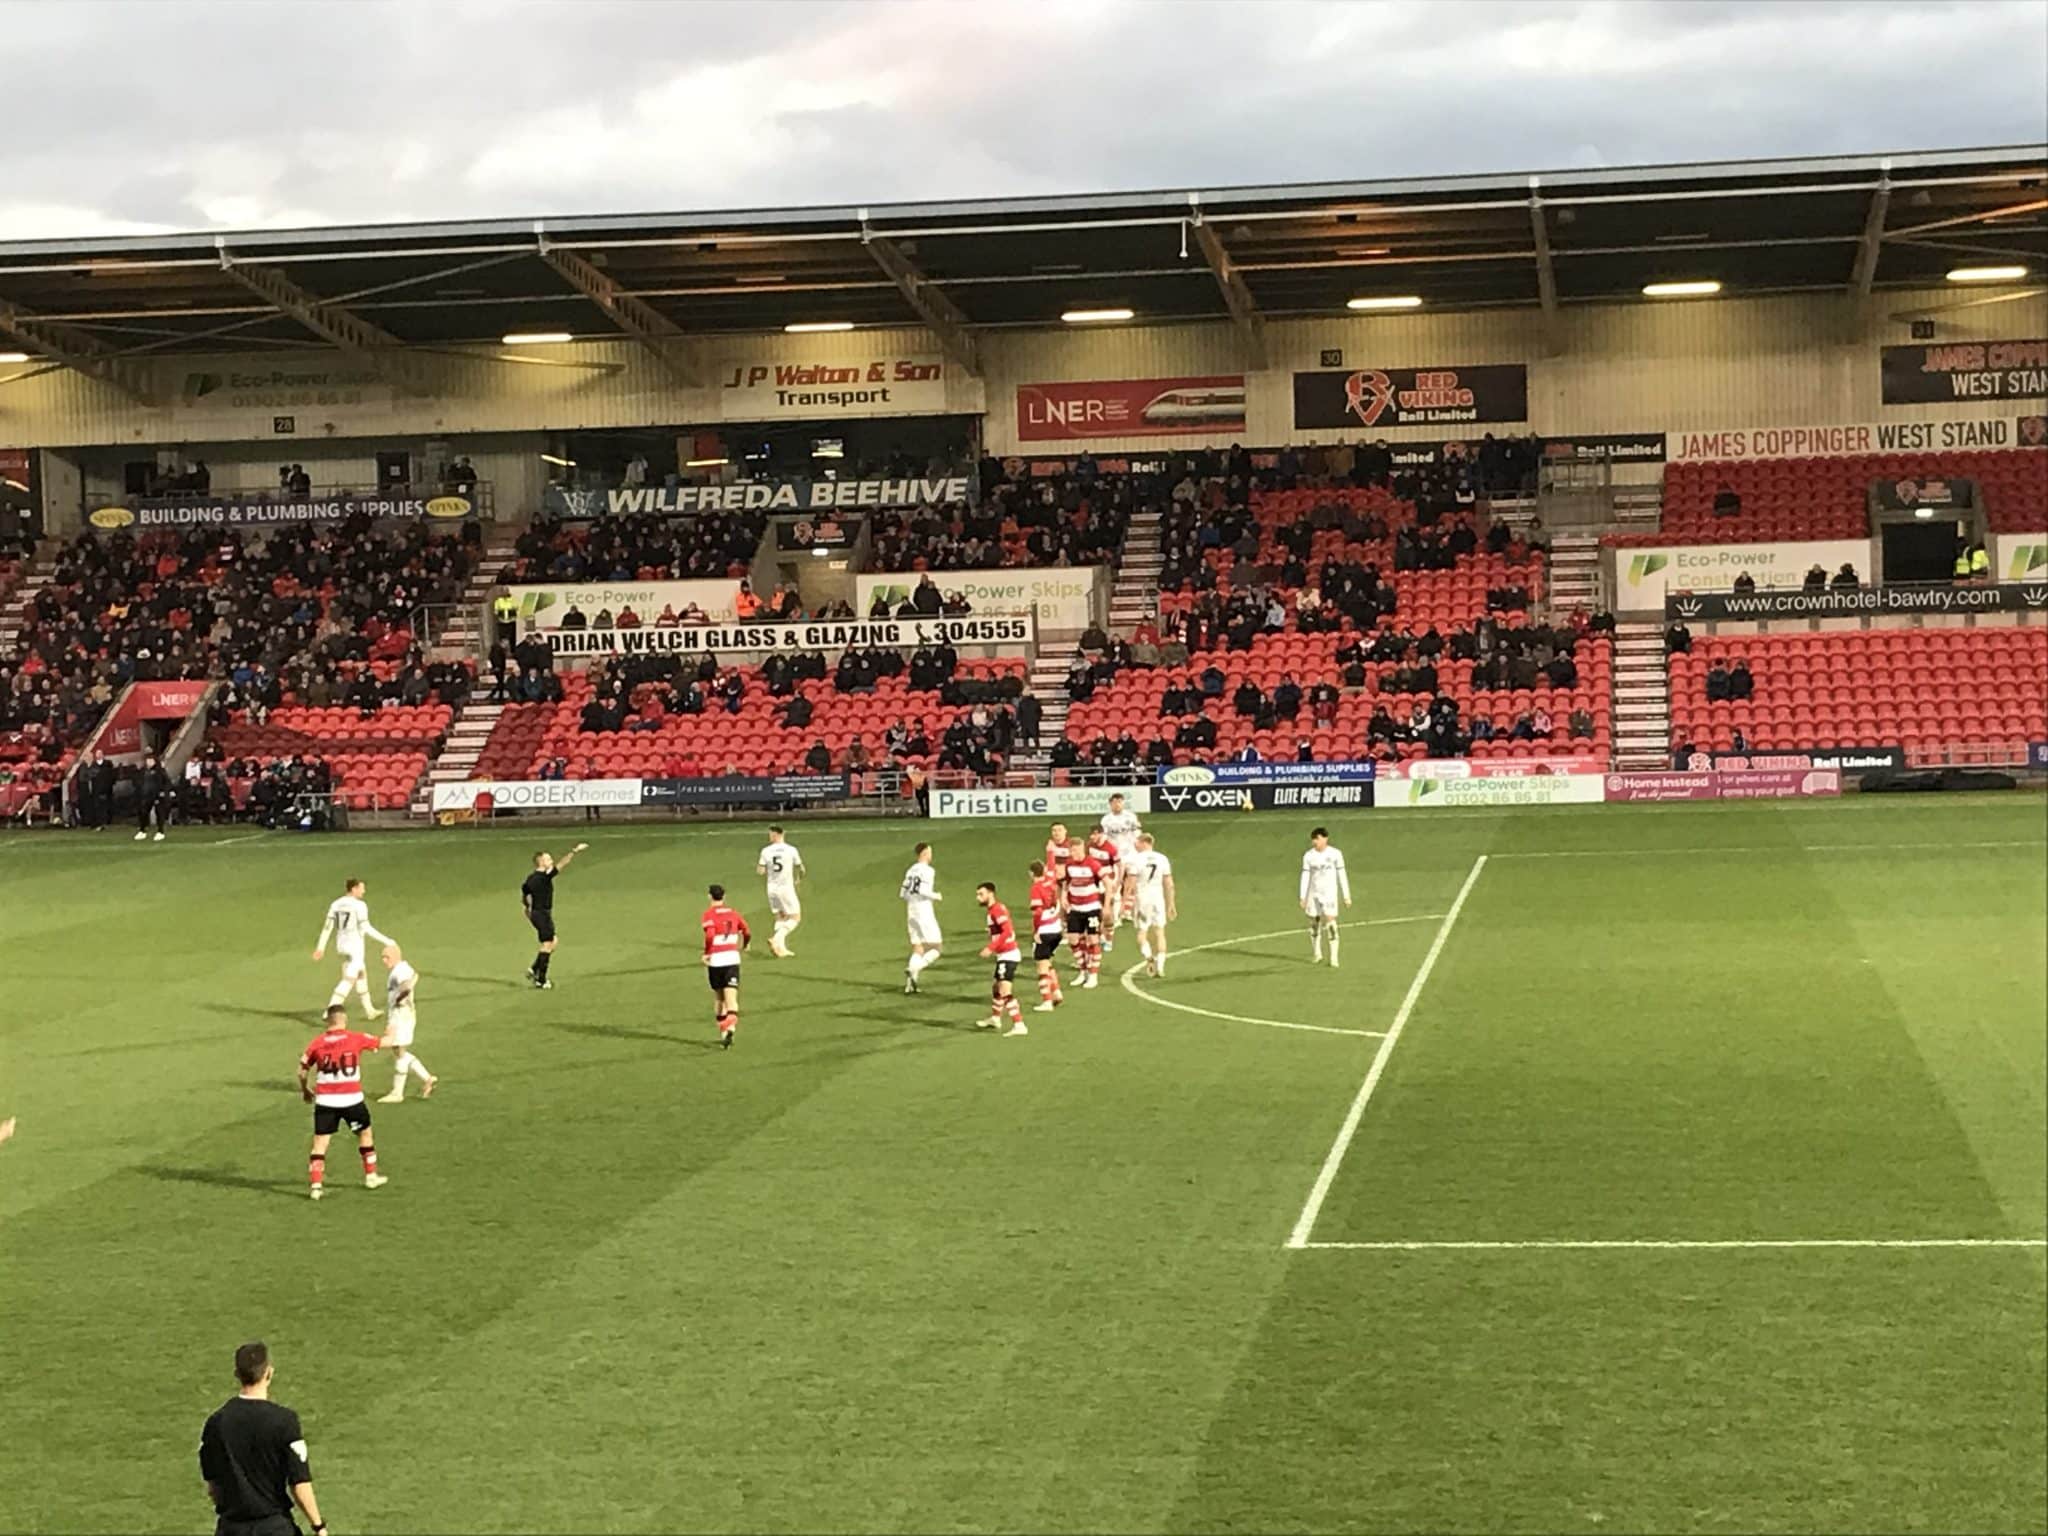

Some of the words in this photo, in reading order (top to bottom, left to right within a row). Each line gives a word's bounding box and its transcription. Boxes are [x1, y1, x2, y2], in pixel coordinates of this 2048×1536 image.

[1323, 351, 1340, 365] 30
[725, 368, 743, 388] J
[747, 366, 768, 387] P
[775, 365, 859, 386] Walton
[867, 362, 885, 382] &
[893, 361, 941, 381] Son
[1416, 372, 1458, 391] RED
[1951, 372, 2002, 396] WEST
[776, 388, 891, 407] Transport
[1400, 388, 1474, 408] VIKING
[1029, 398, 1105, 426] LNER
[1428, 408, 1477, 421] Limited
[276, 419, 293, 431] 28
[1677, 432, 1746, 458] JAMES
[1752, 426, 1870, 454] COPPINGER
[1877, 423, 1935, 449] WEST
[1941, 420, 2007, 447] STAND
[608, 484, 798, 512] WILFREDA
[810, 477, 968, 506] BEEHIVE
[140, 507, 224, 524] BUILDING
[228, 506, 242, 521] &
[246, 503, 340, 521] PLUMBING
[1677, 552, 1776, 568] Eco-Power
[565, 590, 656, 605] Eco-Power
[1032, 581, 1084, 600] Skips
[1725, 588, 2000, 612] www.crownhotel-bawtry.com
[1040, 604, 1058, 618] 81
[549, 632, 615, 652] DRIAN
[622, 631, 698, 650] WELCH
[706, 627, 776, 648] GLASS
[784, 630, 799, 645] &
[806, 624, 900, 645] GLAZING
[934, 620, 1026, 641] 304555
[1218, 766, 1262, 776] BUILDING
[1326, 764, 1371, 774] SUPPLIES
[1842, 755, 1892, 767] Limited
[1444, 778, 1525, 792] Eco-Power
[1529, 776, 1569, 790] Skips
[1625, 778, 1660, 789] Home
[1663, 776, 1709, 788] Instead
[580, 785, 634, 802] homes
[940, 792, 1048, 814] Pristine
[1196, 789, 1251, 807] OXEN
[1274, 788, 1299, 804] ELITE
[1322, 786, 1361, 803] SPORTS
[772, 856, 783, 872] 5
[1146, 863, 1157, 881] 7
[334, 911, 350, 930] 17
[317, 1052, 357, 1077] 40
